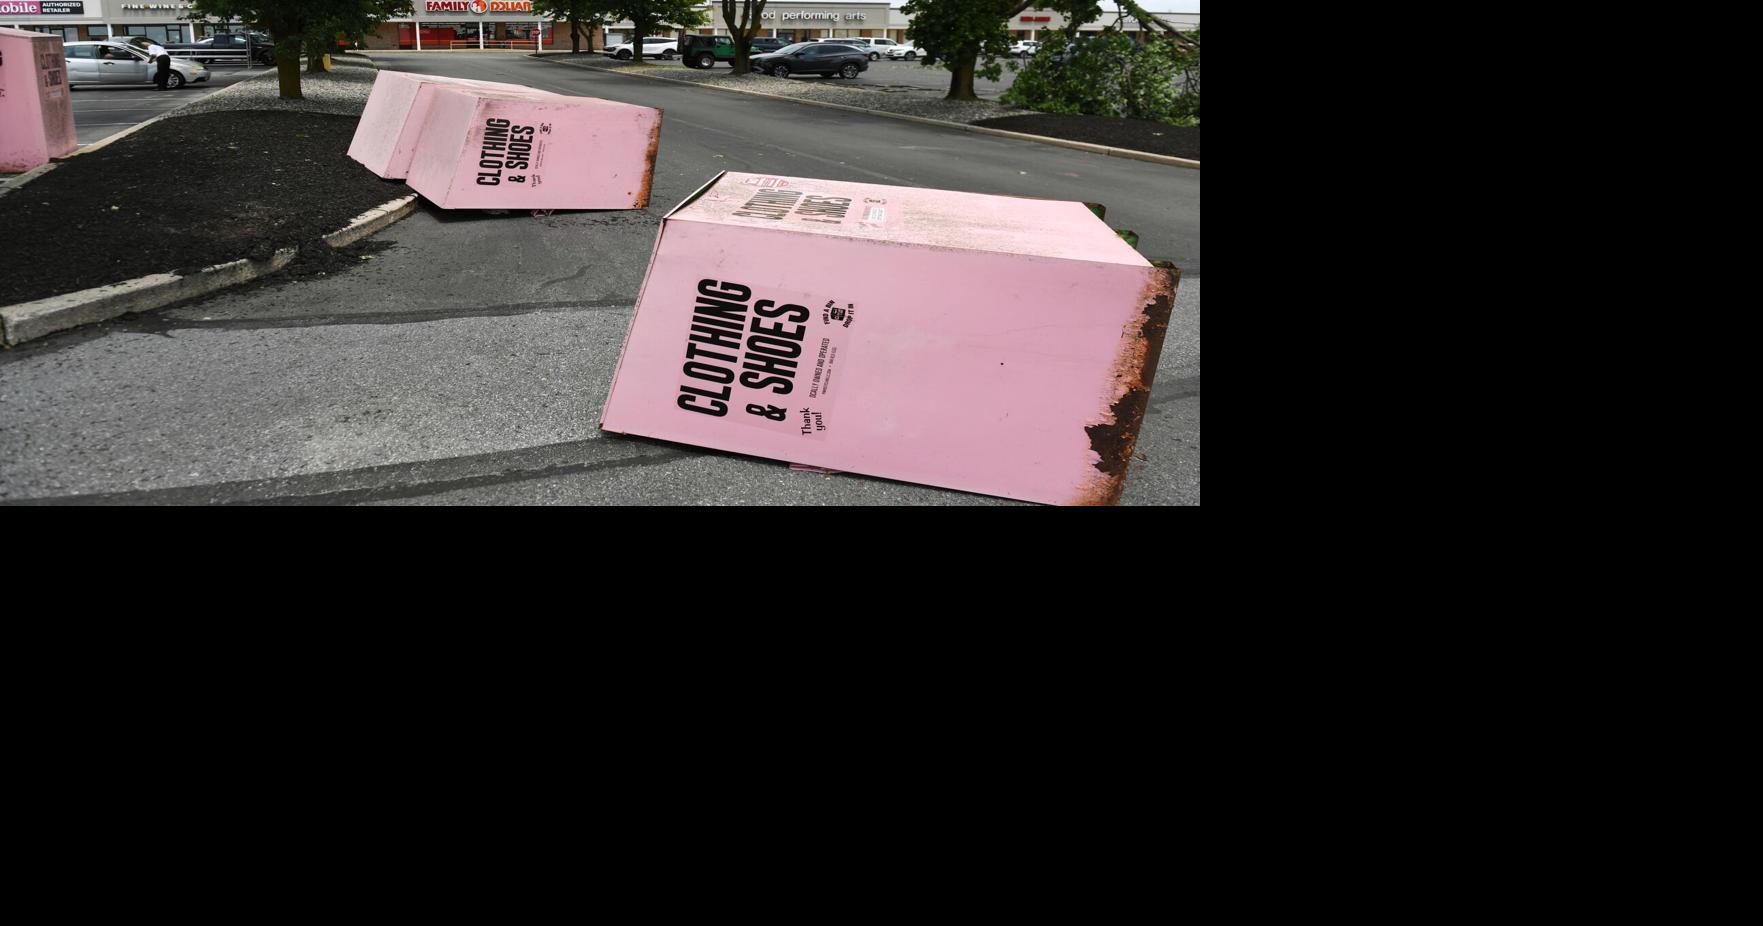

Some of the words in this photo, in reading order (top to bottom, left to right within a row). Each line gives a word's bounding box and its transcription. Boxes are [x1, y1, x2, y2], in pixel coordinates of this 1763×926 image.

[0, 1, 37, 13] obile
[426, 1, 470, 11] FAMILY
[782, 11, 840, 21] performing
[846, 12, 866, 20] arts
[476, 118, 511, 186] CLOTHING
[505, 125, 535, 170] SHOES
[508, 175, 526, 183] &
[842, 315, 853, 328] DROP
[676, 278, 752, 418] CLOTHING
[739, 298, 810, 396] SHOES
[745, 403, 787, 422] &
[800, 407, 812, 436] Thank
[811, 412, 826, 431] you!
